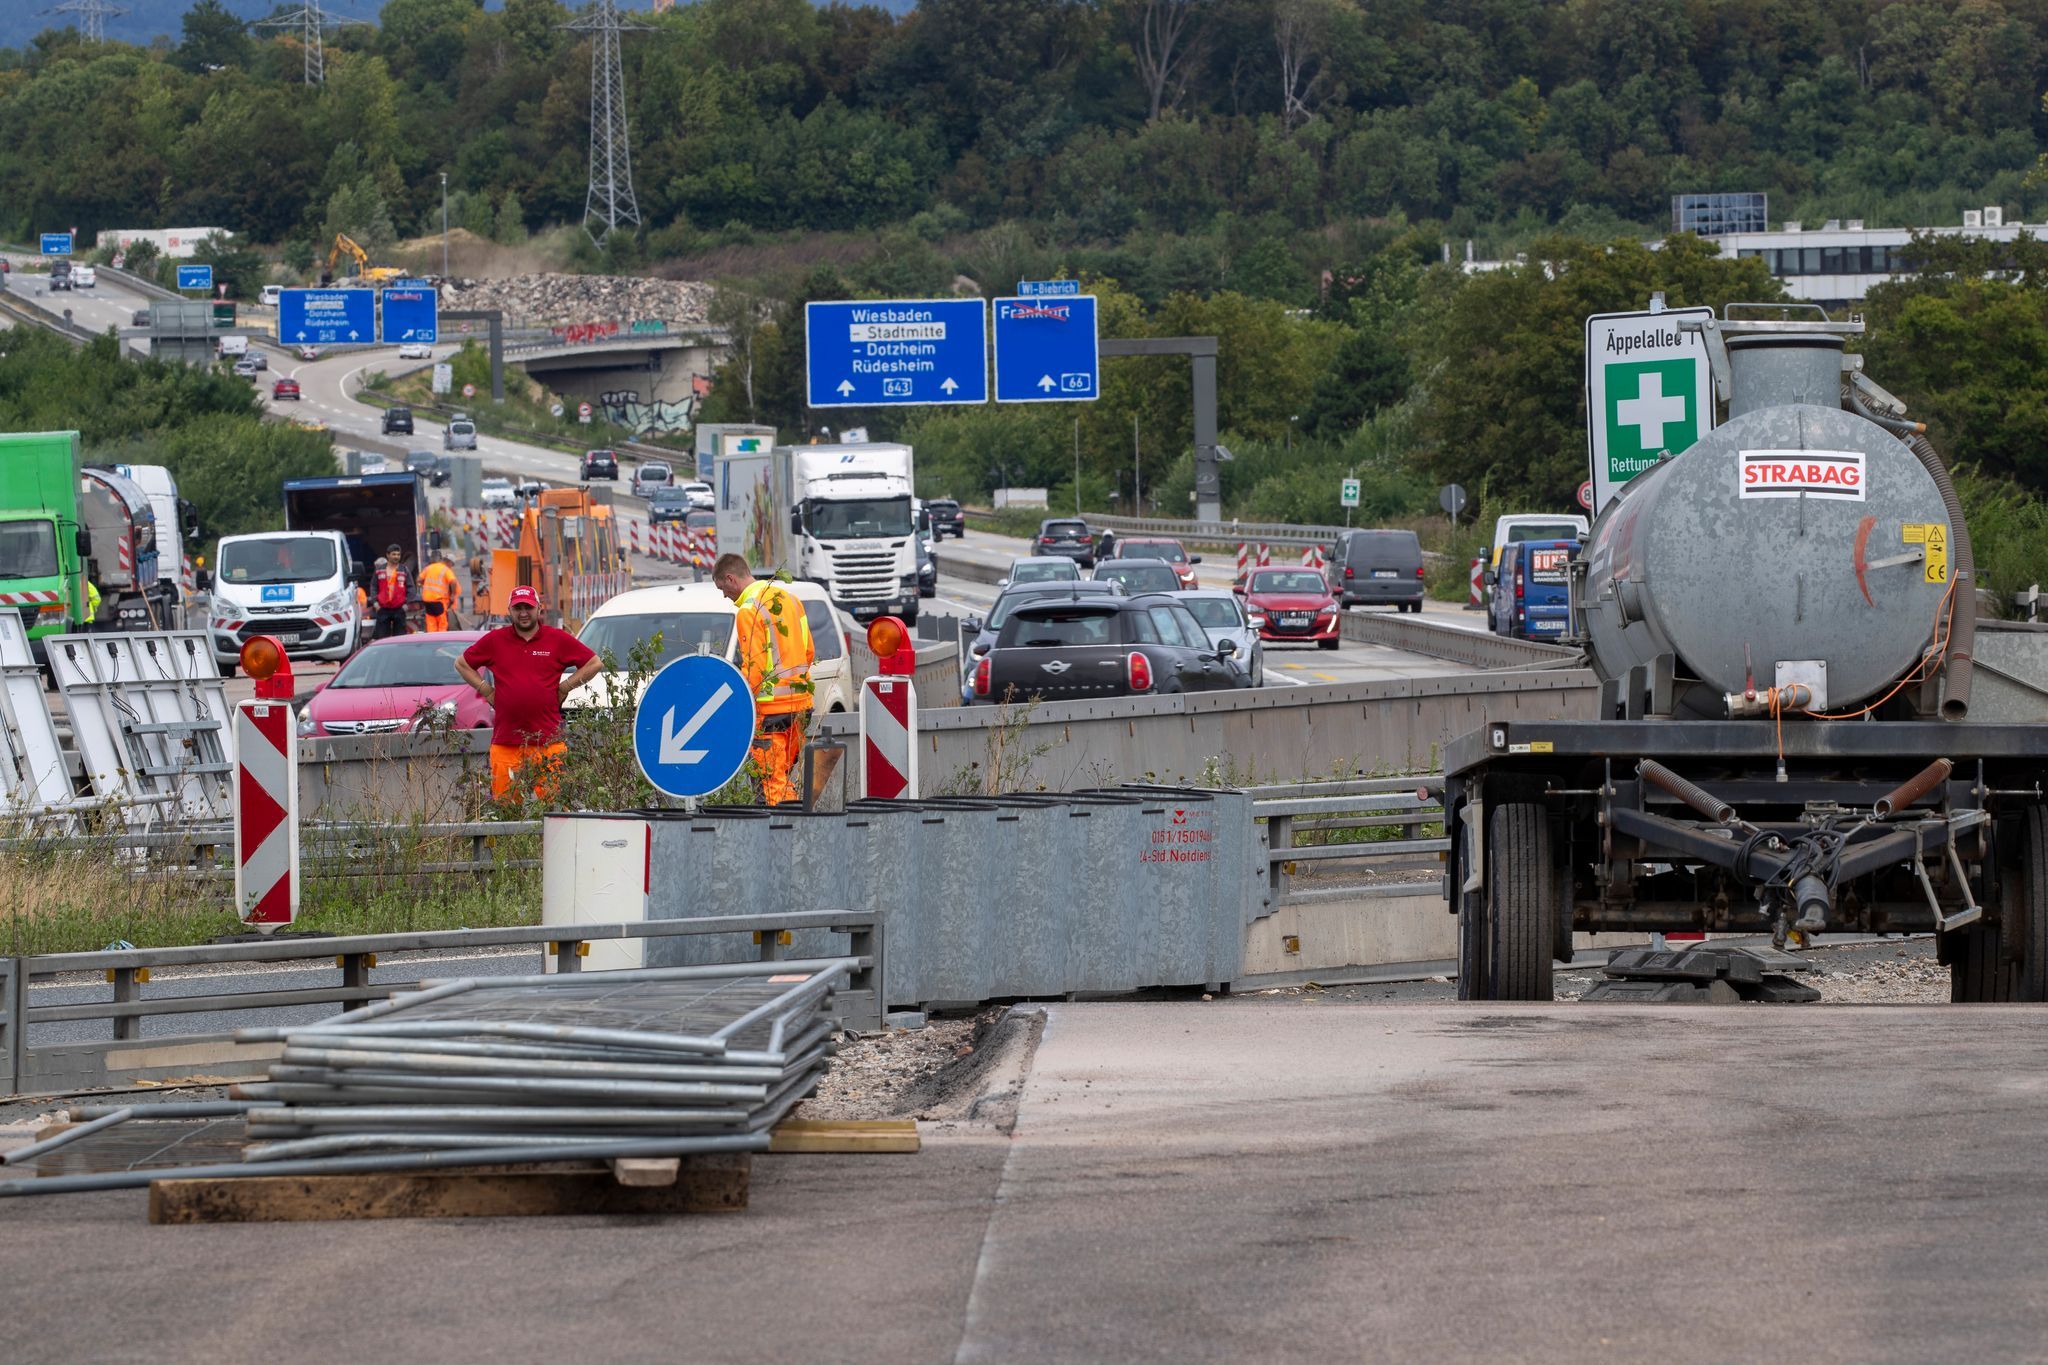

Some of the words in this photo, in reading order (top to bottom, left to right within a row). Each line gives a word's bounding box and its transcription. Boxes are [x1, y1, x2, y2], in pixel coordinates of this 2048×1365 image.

[1022, 283, 1076, 294] WI-Biebrich
[304, 293, 349, 301] Wiesbaden
[852, 309, 932, 322] Wiesbaden
[1001, 305, 1070, 319] Frankfurt
[867, 325, 943, 339] Stadtmitte
[867, 341, 936, 356] Dotzheim
[852, 359, 934, 373] Rüdesheim
[887, 381, 909, 393] 643
[1069, 377, 1083, 388] 66
[1744, 464, 1860, 486] STRABAG
[265, 588, 290, 597] AB
